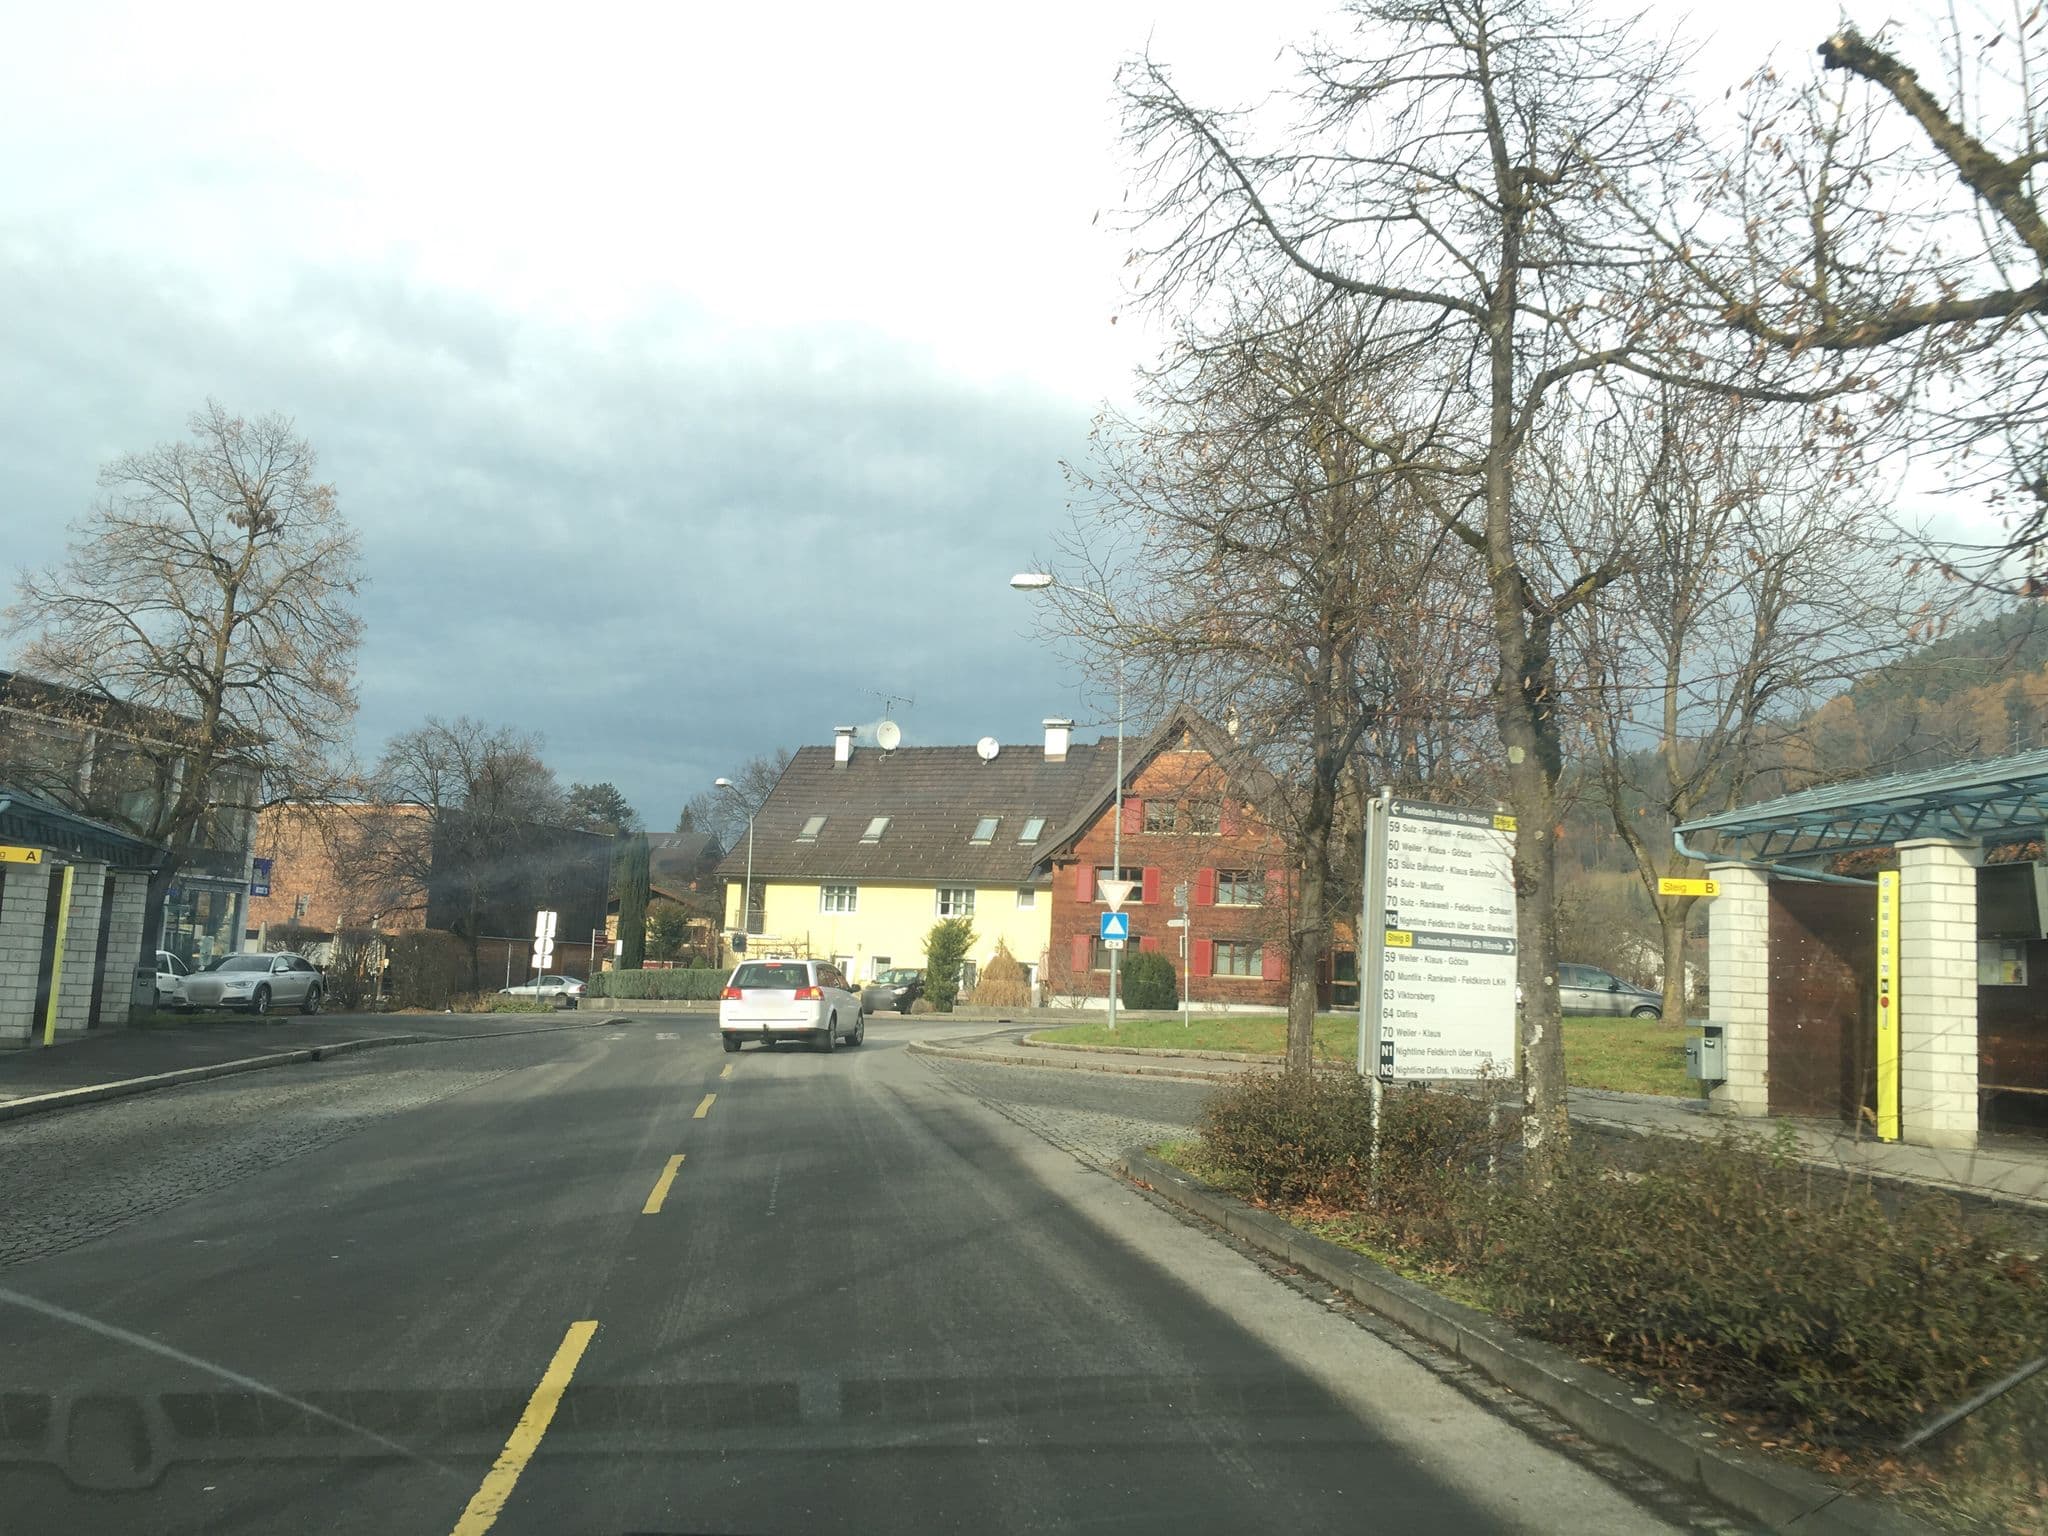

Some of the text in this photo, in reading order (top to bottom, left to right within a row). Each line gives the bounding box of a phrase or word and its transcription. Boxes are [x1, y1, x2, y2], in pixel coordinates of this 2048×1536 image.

[1389, 821, 1400, 832] 59
[1402, 824, 1416, 833] Sulz
[1389, 840, 1399, 851] 60
[1402, 843, 1422, 852] Weiler
[1428, 846, 1446, 855] Klaus
[1452, 848, 1472, 858] Götzis
[26, 851, 36, 861] A
[1388, 859, 1398, 869] 63
[1401, 861, 1415, 870] Sulz
[1417, 863, 1444, 872] Bahnhof
[1450, 867, 1468, 876] Klaus
[1470, 868, 1496, 878] Bahnhof
[1388, 877, 1398, 888] 64
[1401, 880, 1414, 888] Sulz
[1664, 882, 1714, 893] Steig B
[1387, 896, 1398, 906] 70
[1400, 898, 1414, 906] Sulz
[1454, 903, 1484, 912] Feldkirch
[1386, 913, 1398, 925] N2
[1400, 917, 1426, 927] Nightline
[1428, 919, 1455, 928] Feldkirch
[1457, 921, 1470, 930] über
[1385, 952, 1395, 962] 59
[1398, 954, 1418, 963] Weiler
[1425, 956, 1443, 964] Klaus
[1449, 957, 1468, 966] Götzis
[1384, 970, 1395, 981] 60
[1462, 976, 1491, 985] Feldkirch
[1493, 978, 1506, 986] LKH
[1384, 989, 1435, 1002] 63 Viktorsberg
[1383, 1008, 1417, 1019] 64 Dafins
[1382, 1027, 1393, 1038] 70
[1397, 1029, 1416, 1037] Weiler
[1382, 1045, 1393, 1056] N1
[1396, 1047, 1425, 1057] Nightline
[1427, 1048, 1456, 1056] Feldkirch
[1381, 1064, 1393, 1076] N3
[1396, 1066, 1425, 1076] Nightline
